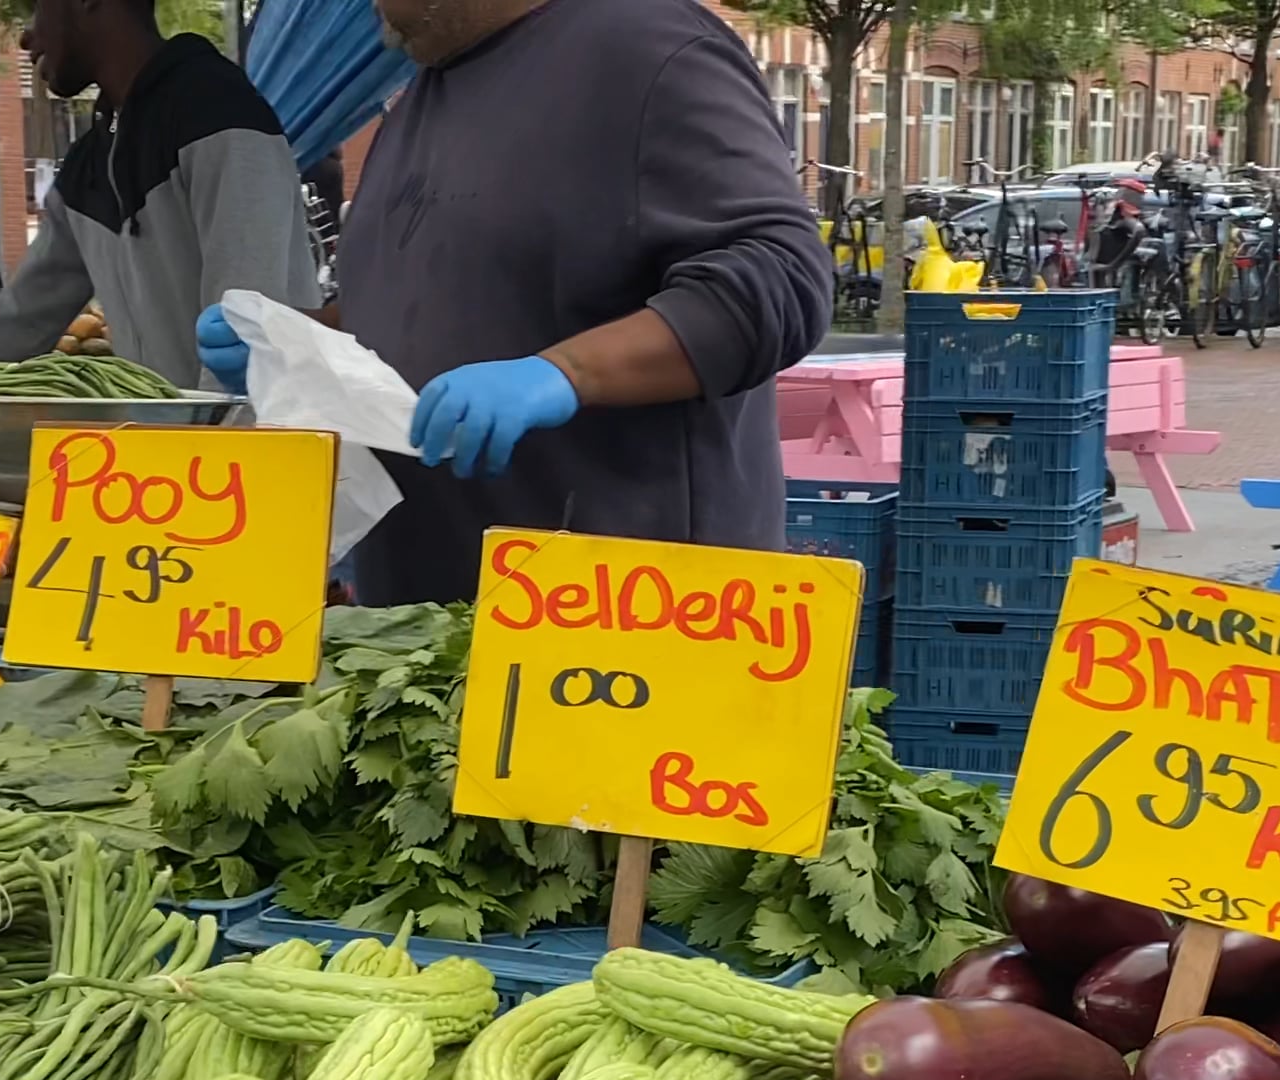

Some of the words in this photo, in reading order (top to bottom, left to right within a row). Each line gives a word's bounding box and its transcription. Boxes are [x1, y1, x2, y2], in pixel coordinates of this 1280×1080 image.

[48, 432, 247, 546] Pooy
[491, 539, 815, 682] SelDeRij
[650, 752, 769, 827] Bos
